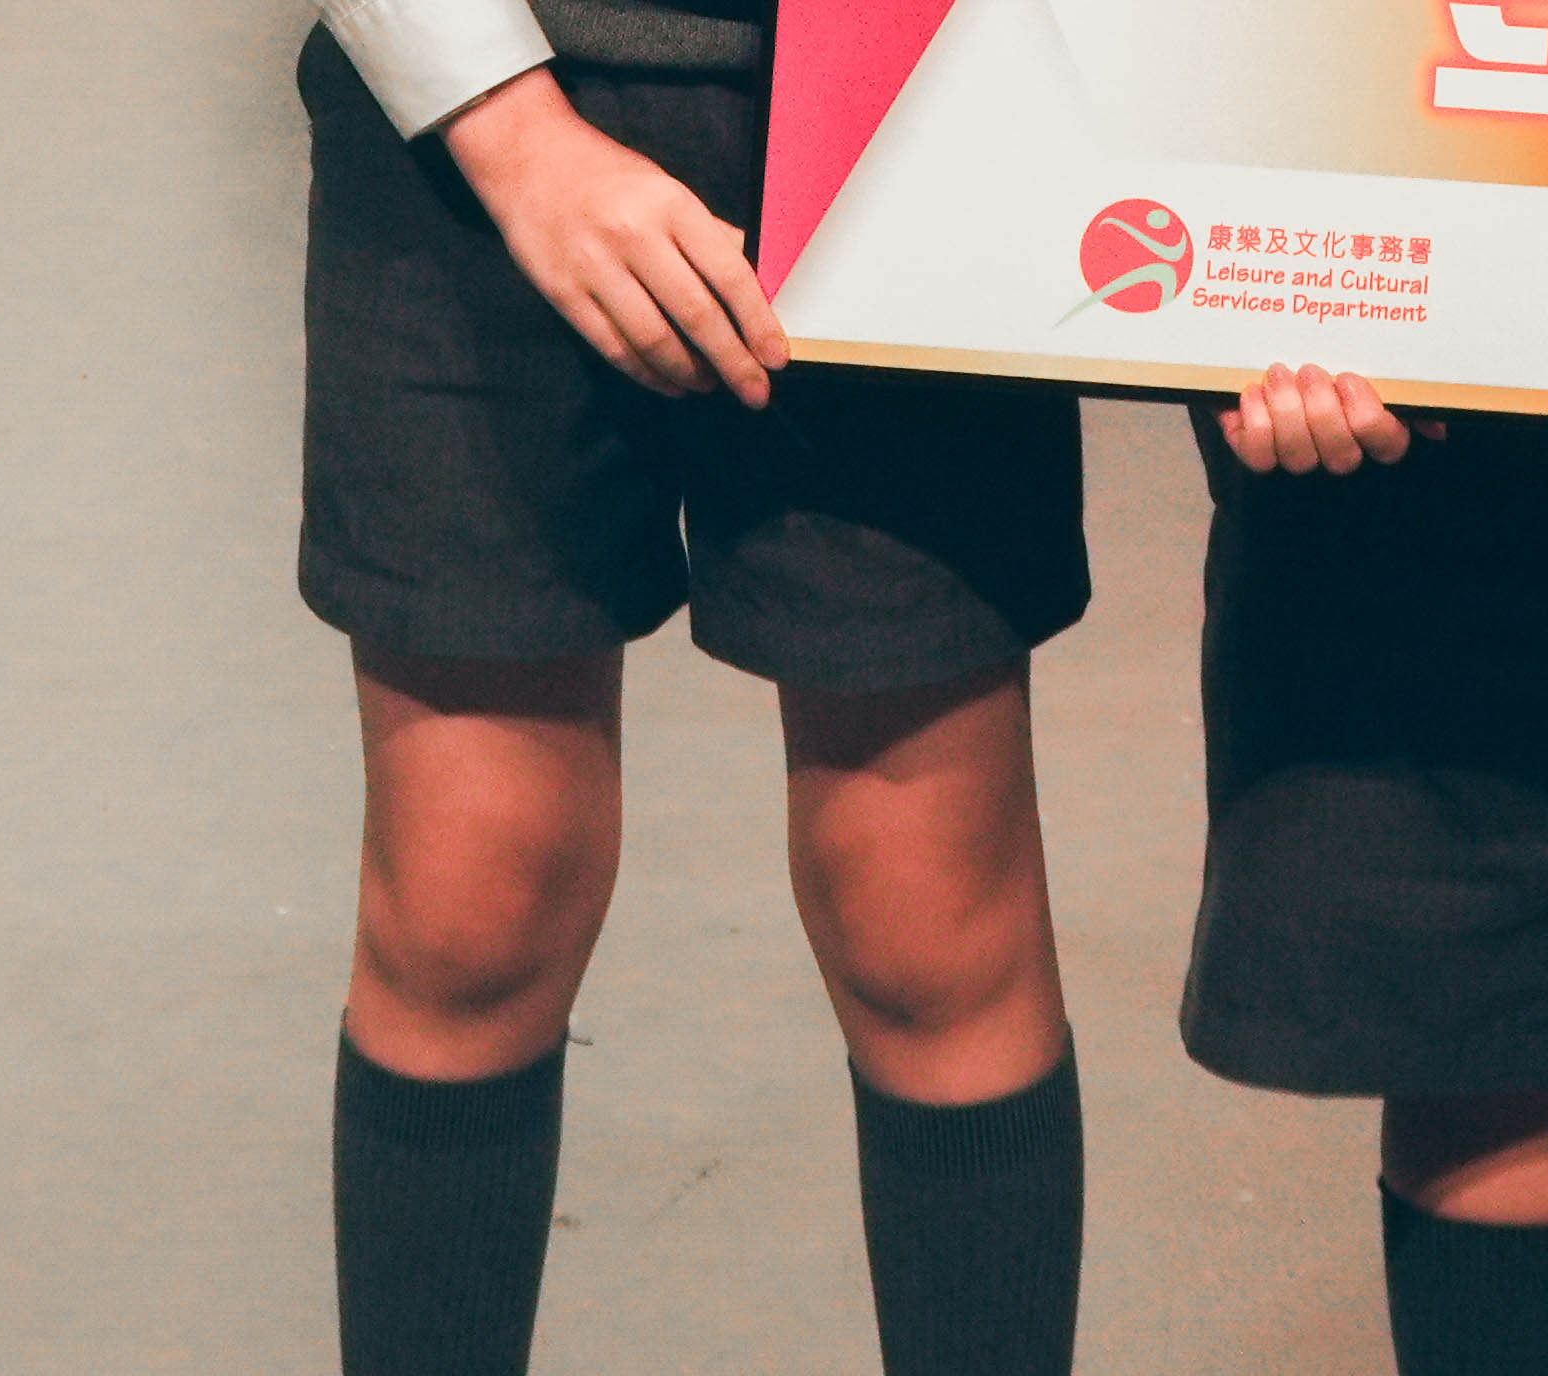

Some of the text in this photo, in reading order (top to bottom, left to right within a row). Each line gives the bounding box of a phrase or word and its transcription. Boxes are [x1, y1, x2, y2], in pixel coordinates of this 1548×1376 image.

[1207, 222, 1432, 265] 康樂及文化事務署
[1205, 261, 1428, 294] Leisure and Cultural
[1193, 288, 1427, 323] Services Department
